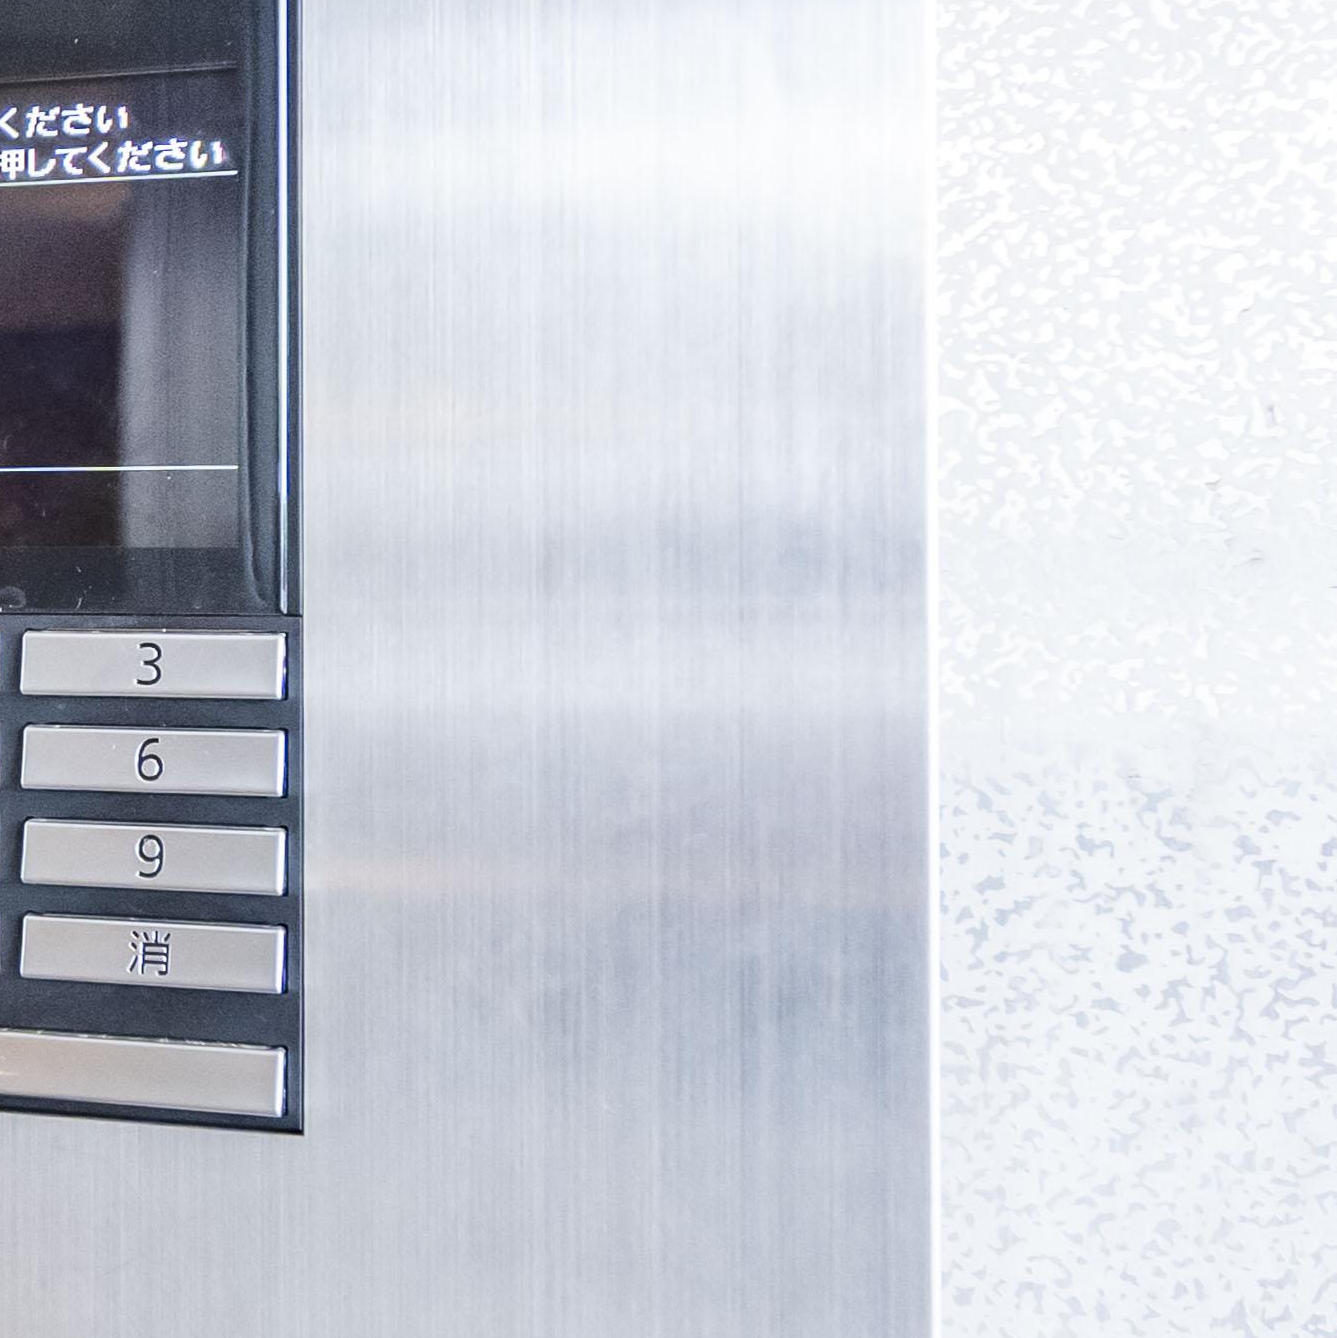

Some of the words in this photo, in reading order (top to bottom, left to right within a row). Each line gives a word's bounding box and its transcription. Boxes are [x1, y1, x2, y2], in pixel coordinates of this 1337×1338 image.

[136, 642, 162, 686] 3
[136, 737, 163, 782] 6
[136, 835, 164, 880] 9
[127, 929, 172, 977] 消
